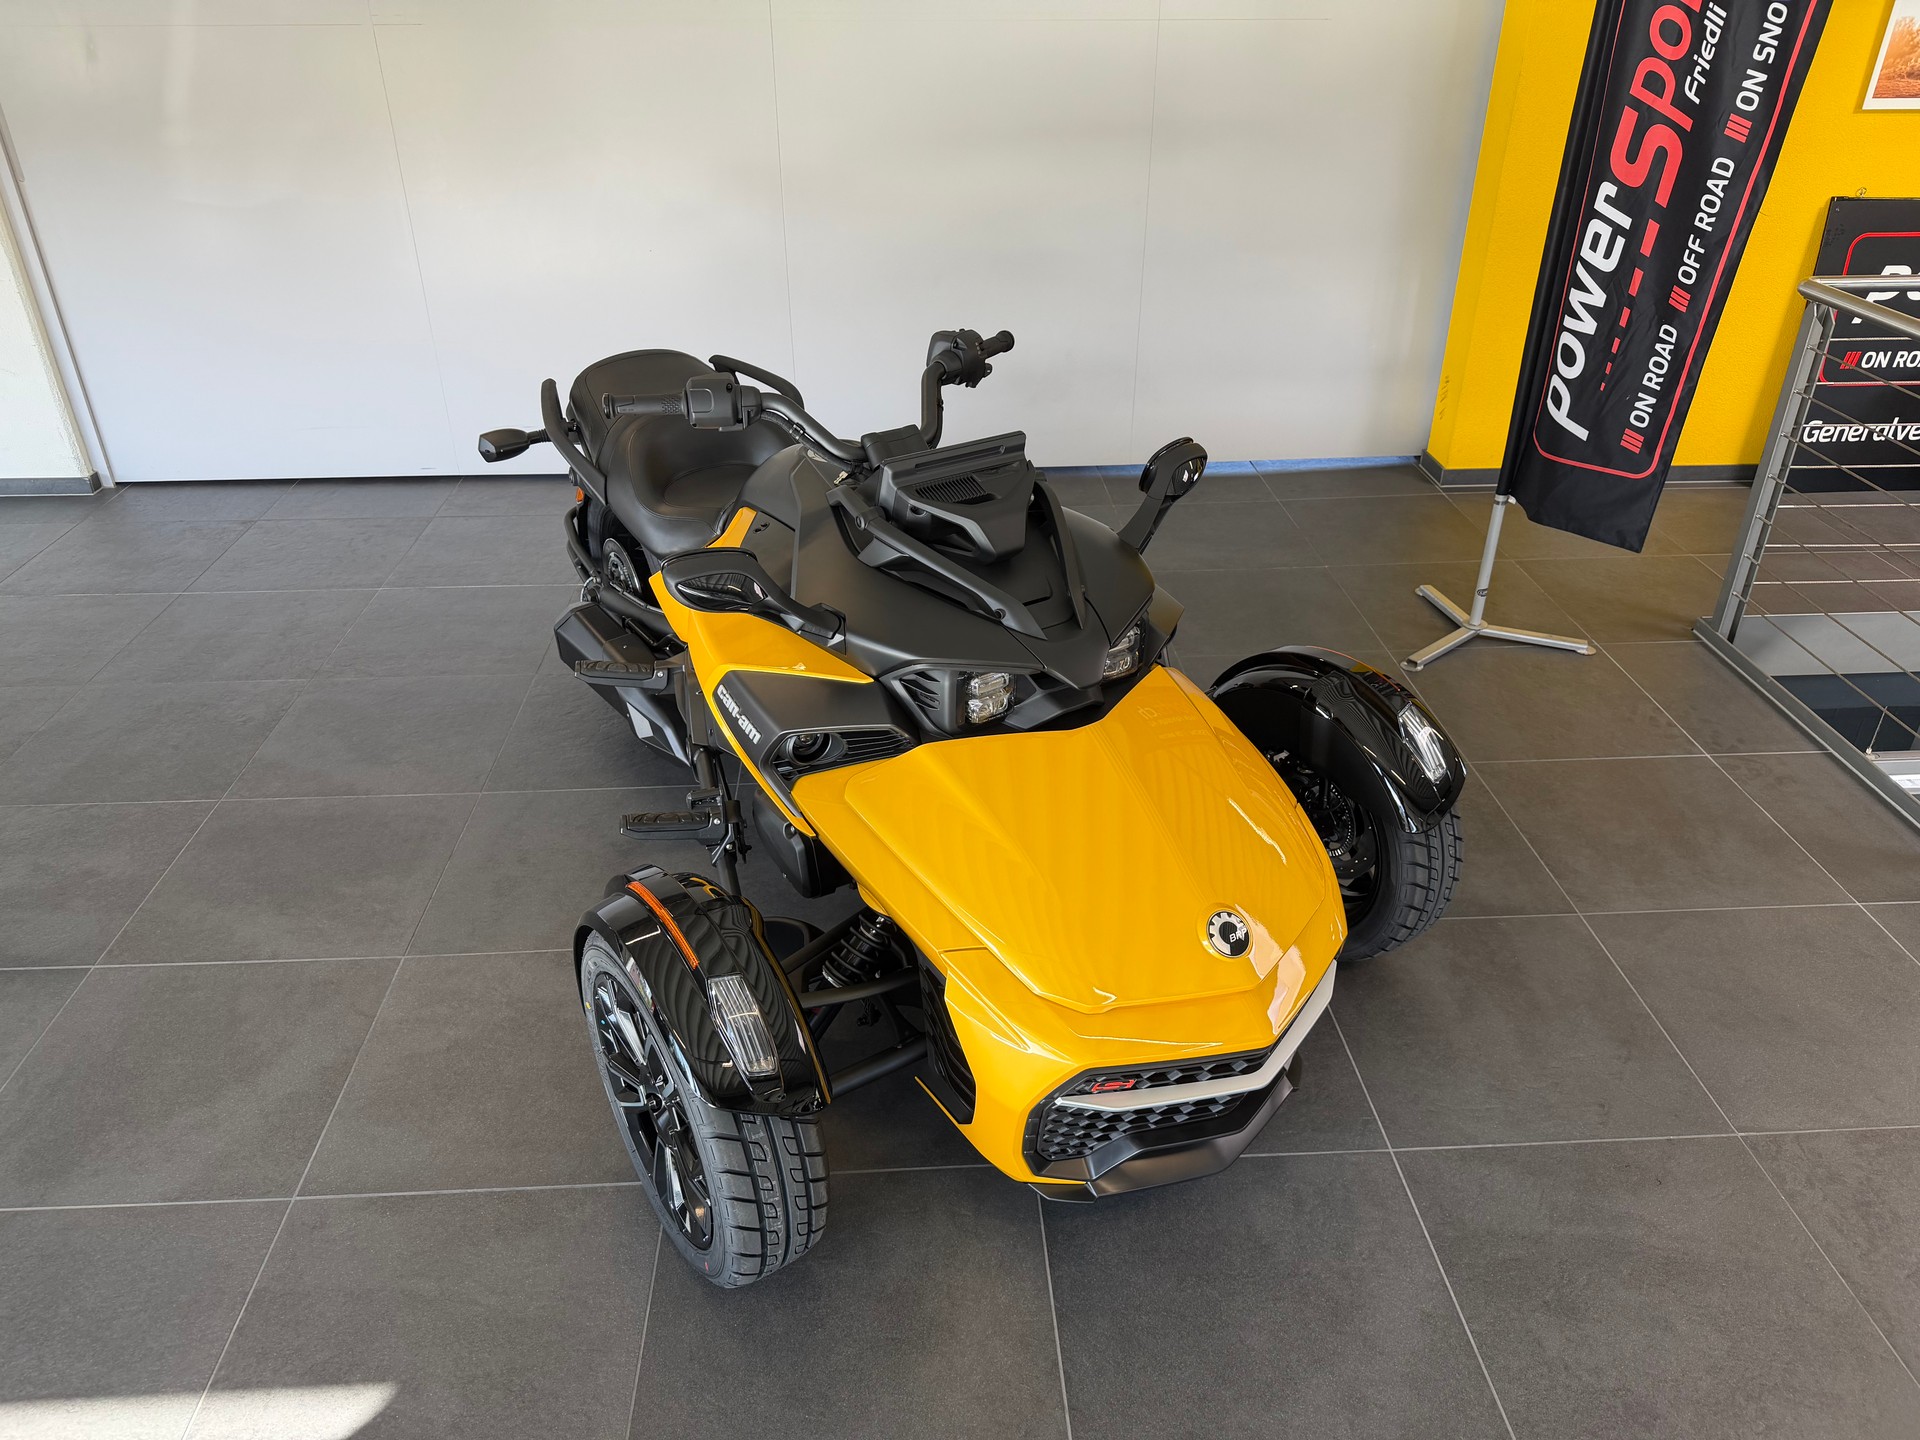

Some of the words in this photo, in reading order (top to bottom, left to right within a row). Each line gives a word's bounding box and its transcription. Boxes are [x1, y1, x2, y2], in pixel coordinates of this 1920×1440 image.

[1684, 1, 1728, 105] Friedli
[1753, 2, 1788, 64] SNO
[1736, 69, 1768, 111] ON
[1694, 156, 1735, 232] ROAD
[1678, 233, 1706, 285] OFF
[1642, 323, 1677, 391] ROAD
[1861, 351, 1892, 369] ON
[1892, 351, 1920, 368] RO
[1630, 392, 1658, 429] ON
[717, 684, 761, 744] can-am
[1230, 928, 1246, 942] BRP
